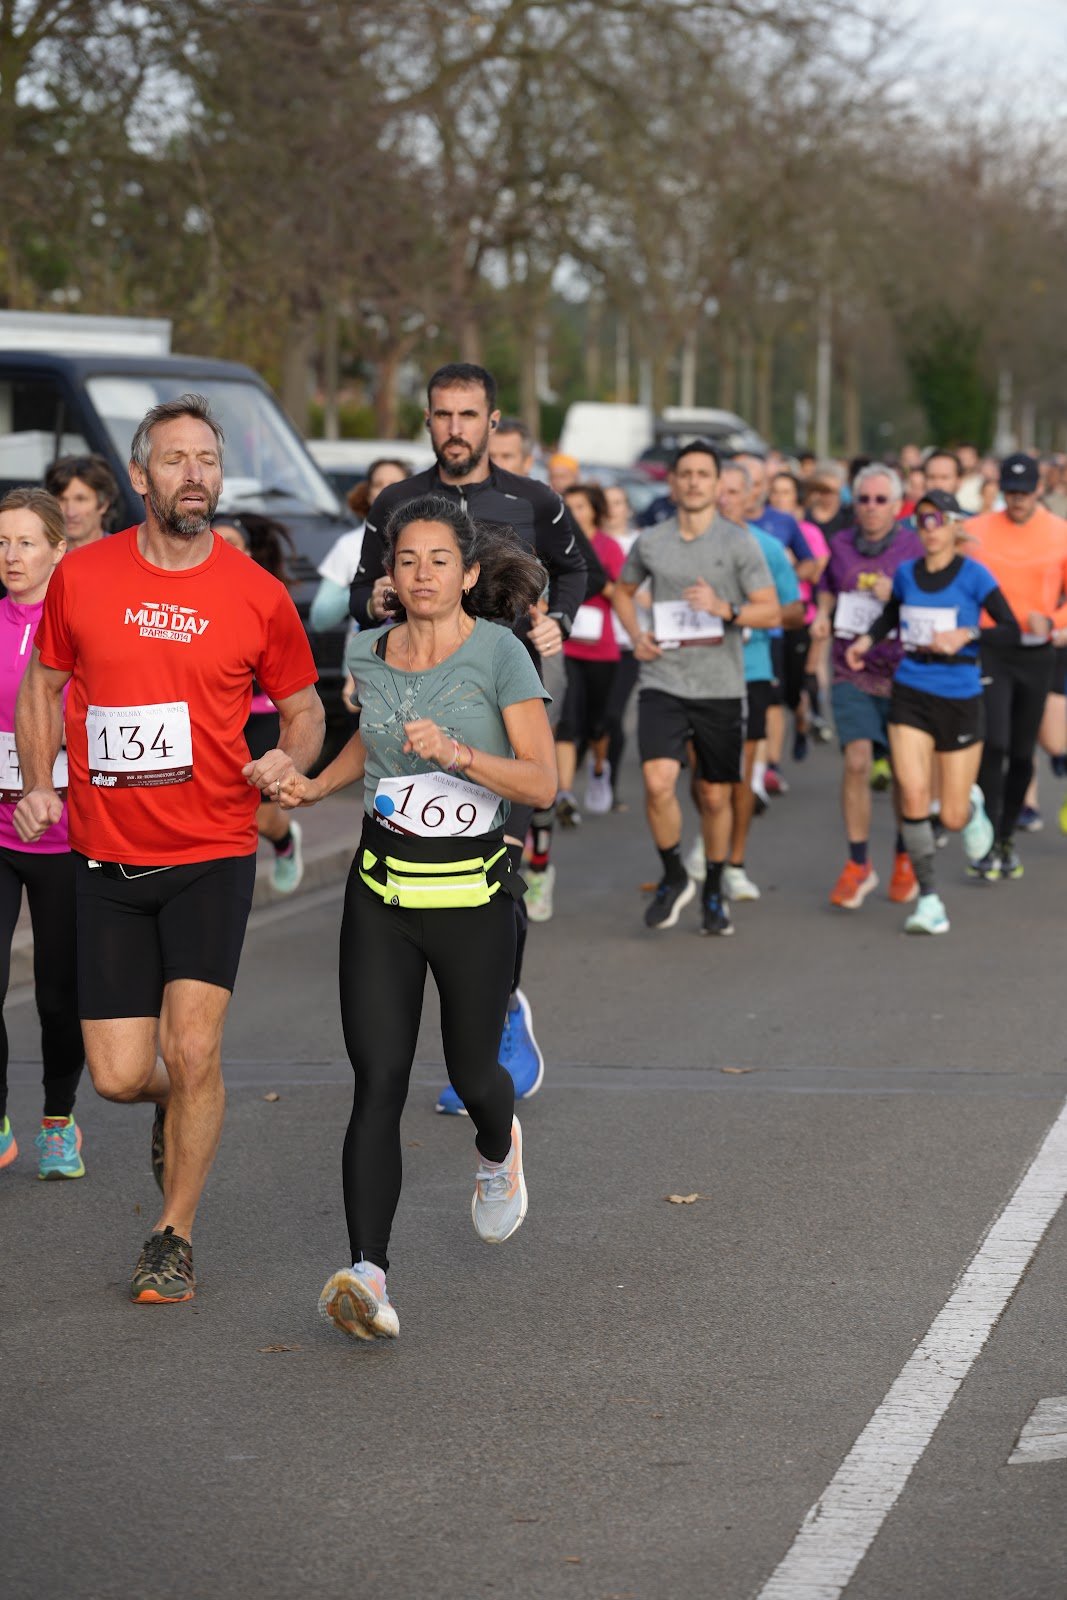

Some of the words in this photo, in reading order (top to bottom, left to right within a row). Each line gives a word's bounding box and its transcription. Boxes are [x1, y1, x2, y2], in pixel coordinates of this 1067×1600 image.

[124, 608, 169, 629] MUD
[170, 613, 210, 636] DAY
[161, 603, 178, 613] THE
[98, 722, 174, 761] 134
[395, 783, 477, 835] 169
